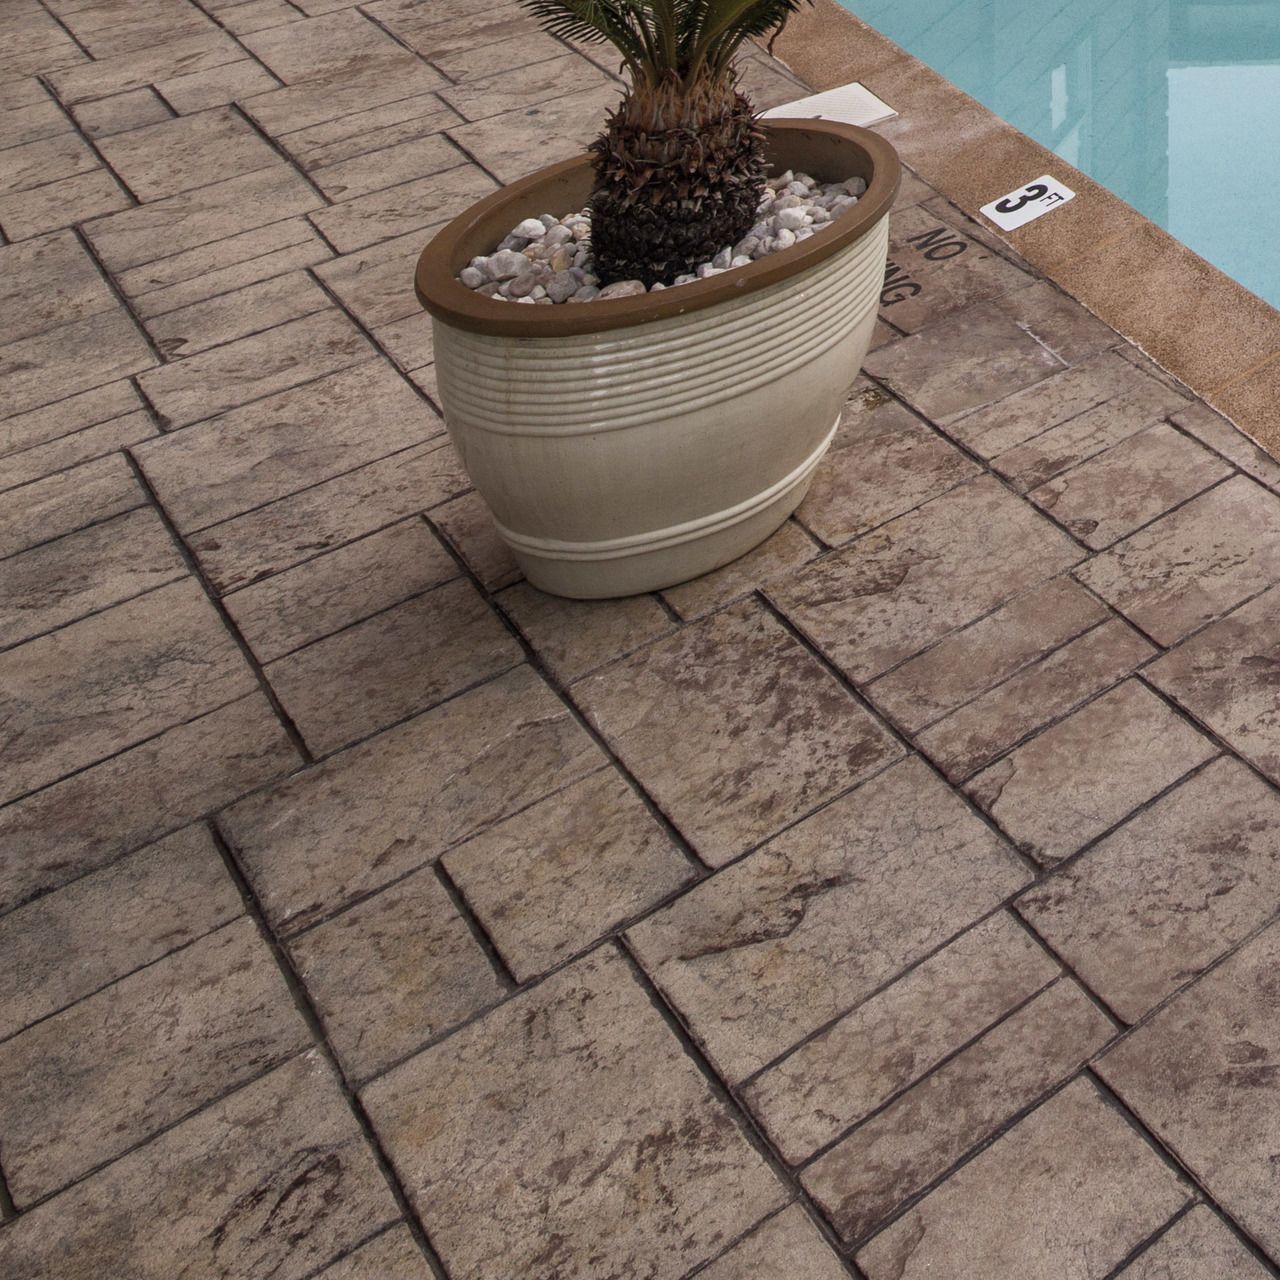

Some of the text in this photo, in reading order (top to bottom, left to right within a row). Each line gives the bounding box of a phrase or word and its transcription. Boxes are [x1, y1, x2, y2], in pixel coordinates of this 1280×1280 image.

[994, 184, 1064, 213] 3 FT
[906, 227, 967, 261] NO
